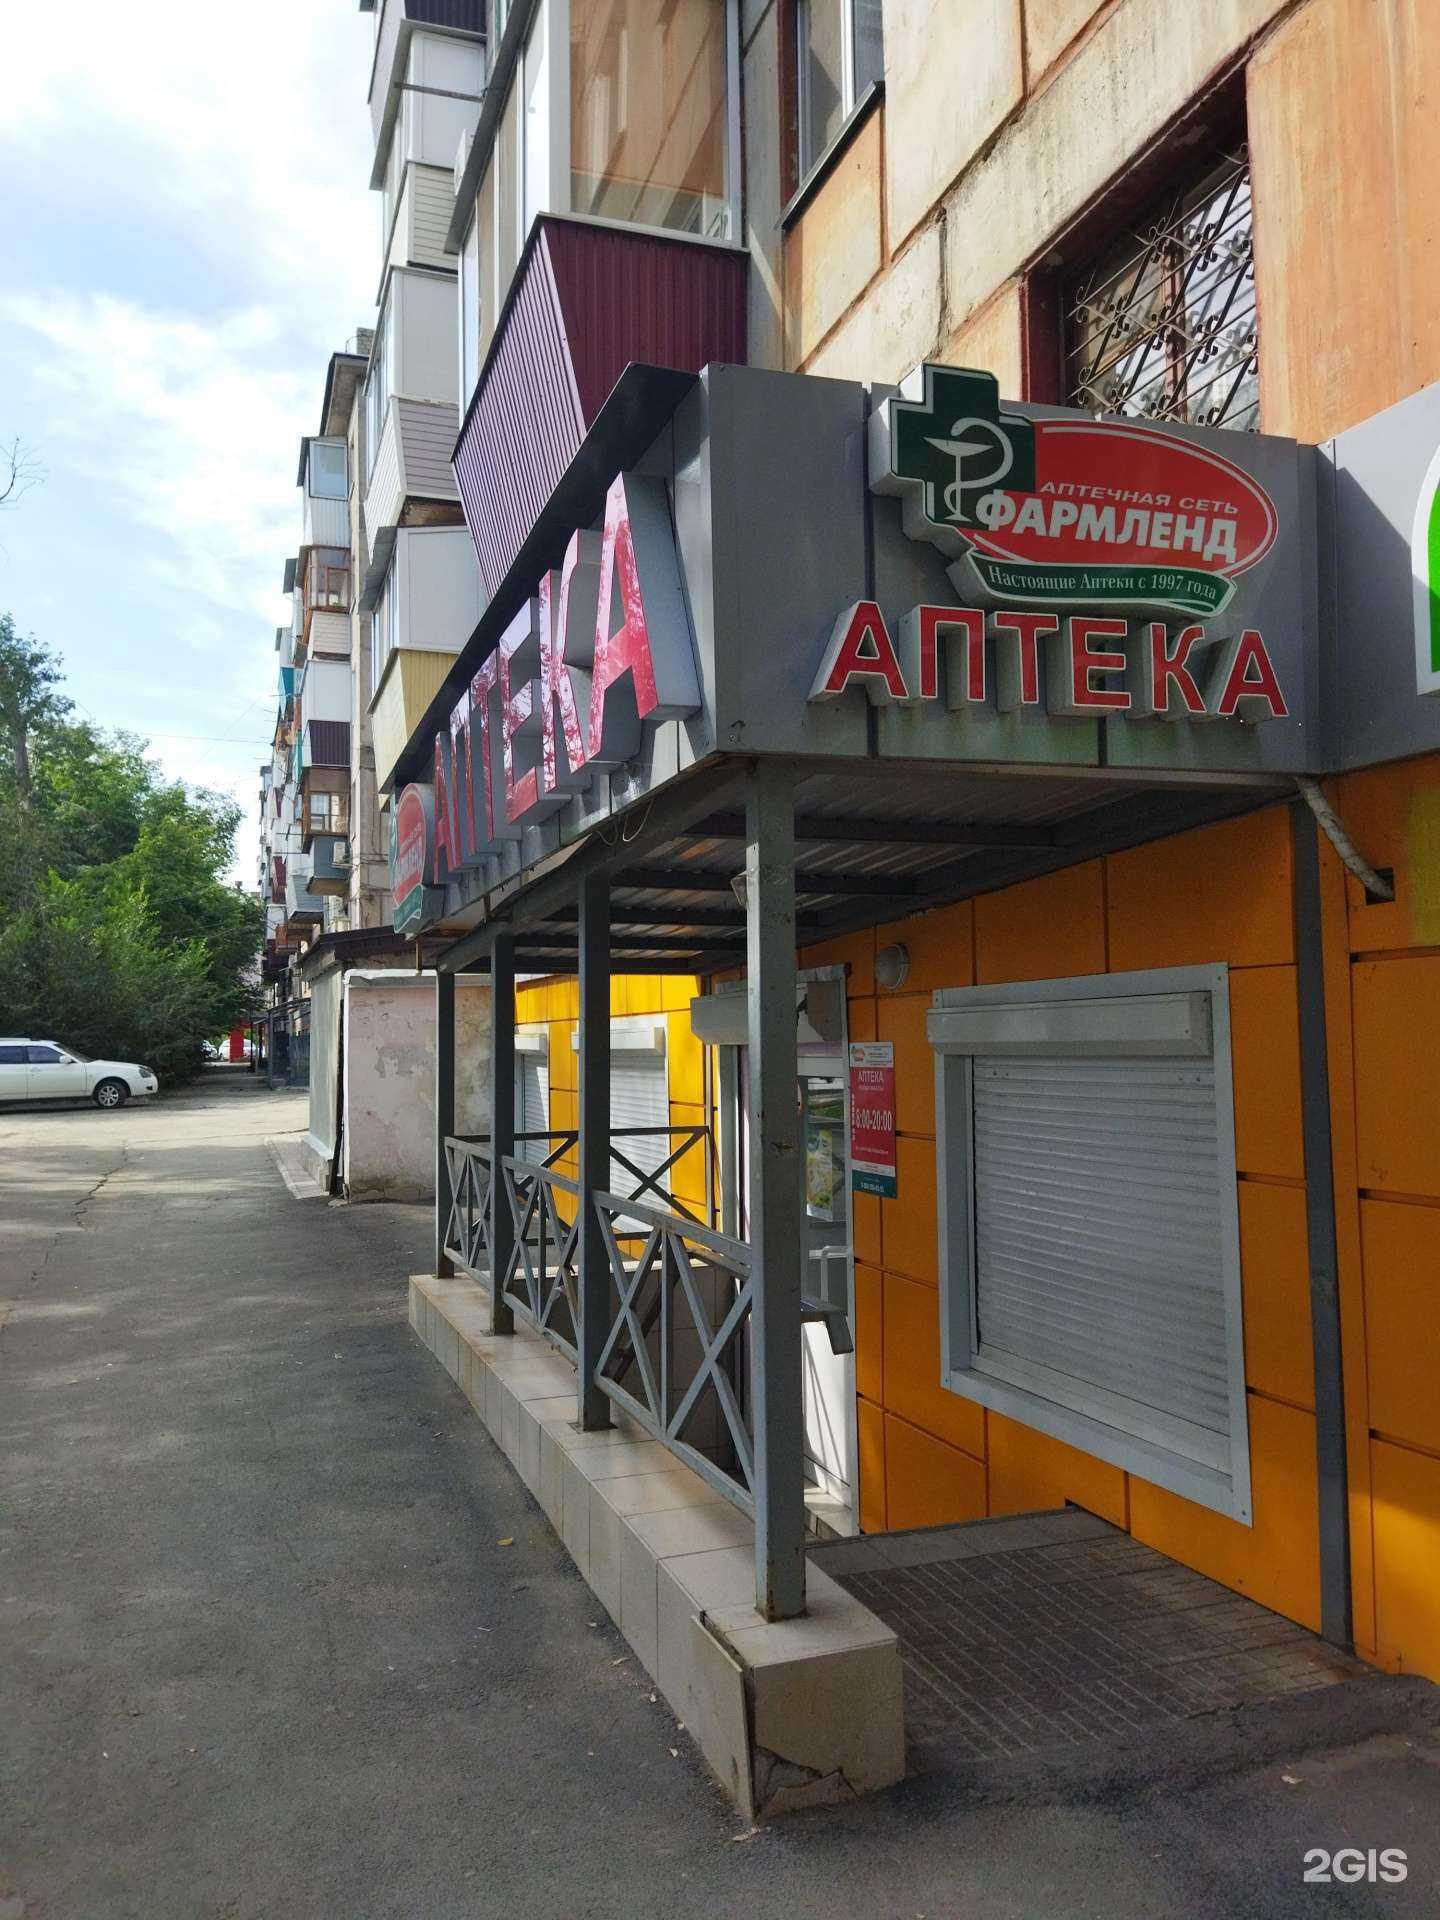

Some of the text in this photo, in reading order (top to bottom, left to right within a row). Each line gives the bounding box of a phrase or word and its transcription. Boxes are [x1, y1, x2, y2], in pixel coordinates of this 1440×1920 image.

[1039, 481, 1240, 514] АПТЕЧНАЯ СЕТЬ
[975, 488, 1238, 564] ФАРМЛЕНД
[987, 564, 1216, 600] Настоящие Аптеки с 1997 года
[433, 470, 660, 884] АПТЕКА
[823, 600, 1290, 718] АПТЕКА
[858, 1071, 885, 1083] АПТЕКА
